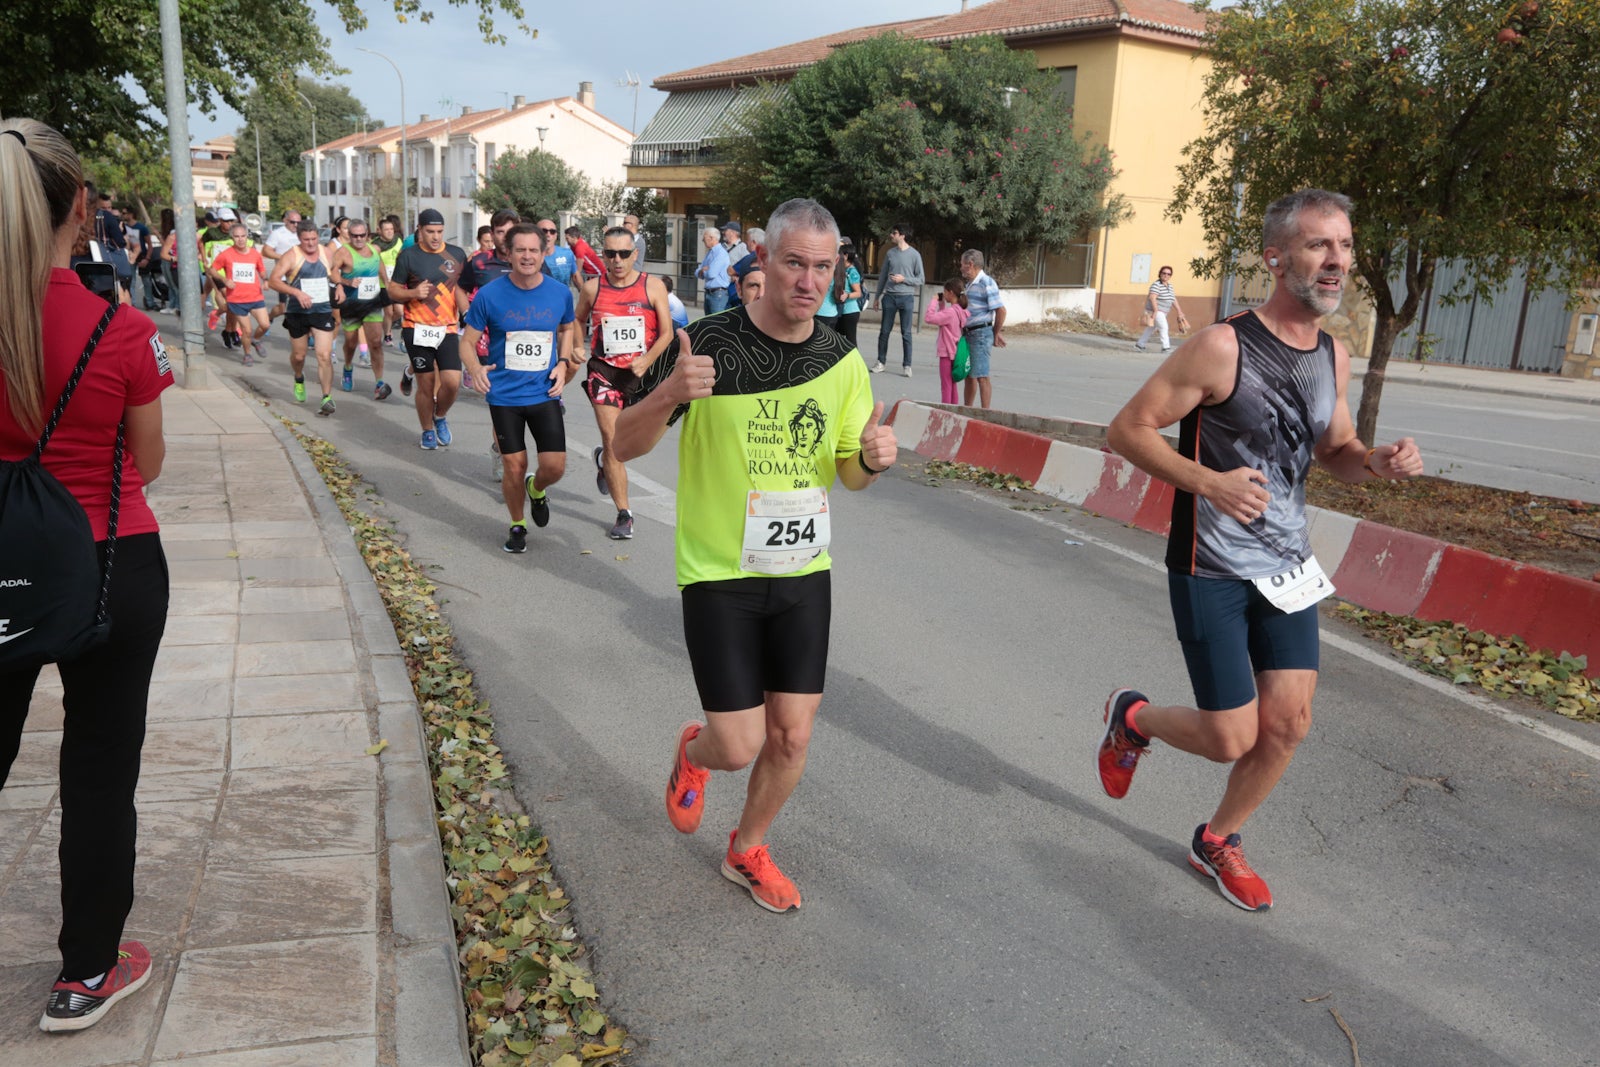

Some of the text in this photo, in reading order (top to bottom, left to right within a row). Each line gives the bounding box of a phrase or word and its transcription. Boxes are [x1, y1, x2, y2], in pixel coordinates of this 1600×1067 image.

[421, 329, 440, 338] 364
[612, 328, 637, 340] 150
[515, 343, 542, 357] 683
[754, 398, 780, 419] XI
[748, 420, 783, 432] Prueba
[747, 432, 783, 445] Fondo
[747, 448, 776, 459] VILLA
[748, 460, 818, 475] ROMANA
[765, 518, 816, 546] 254
